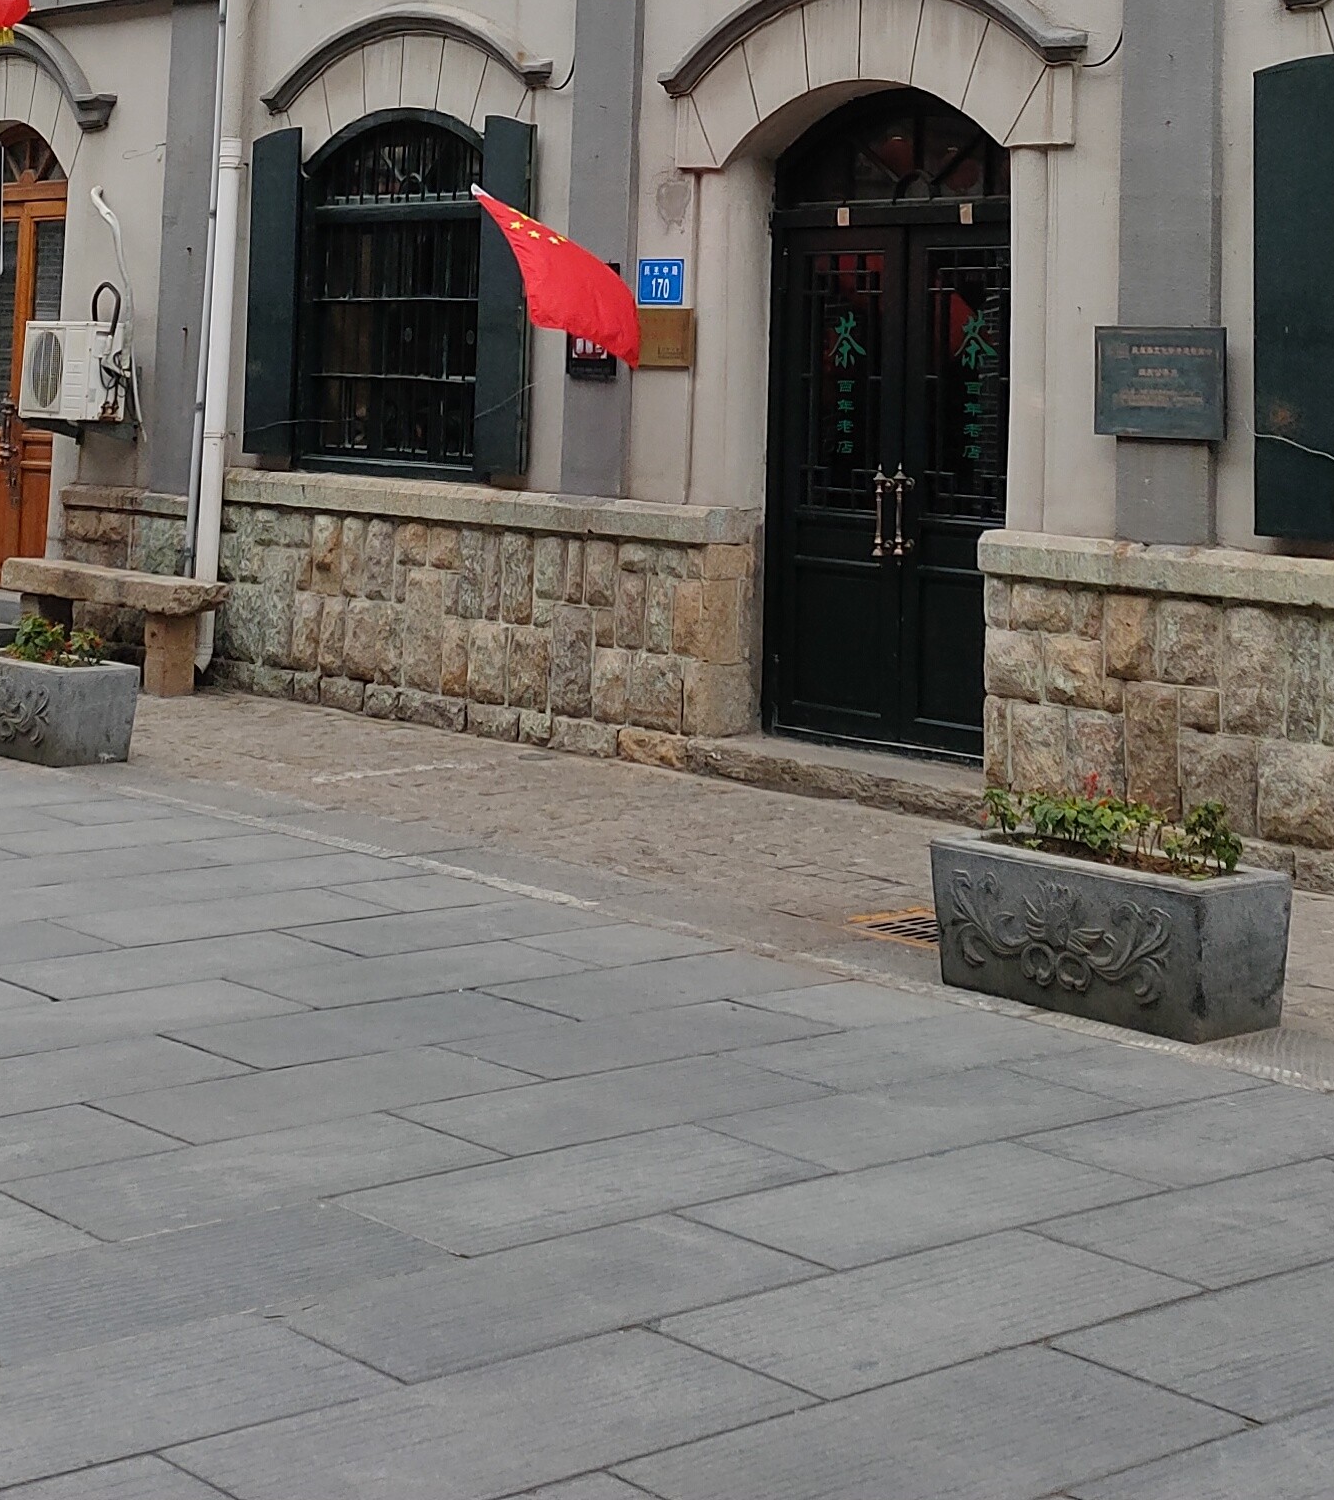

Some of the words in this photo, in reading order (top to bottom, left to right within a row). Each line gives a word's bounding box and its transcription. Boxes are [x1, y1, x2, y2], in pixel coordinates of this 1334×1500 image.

[650, 277, 670, 299] 170
[828, 311, 867, 370] 茶
[953, 310, 998, 371] 茶
[836, 379, 856, 455] 百年老店
[962, 381, 983, 461] 百年老店
